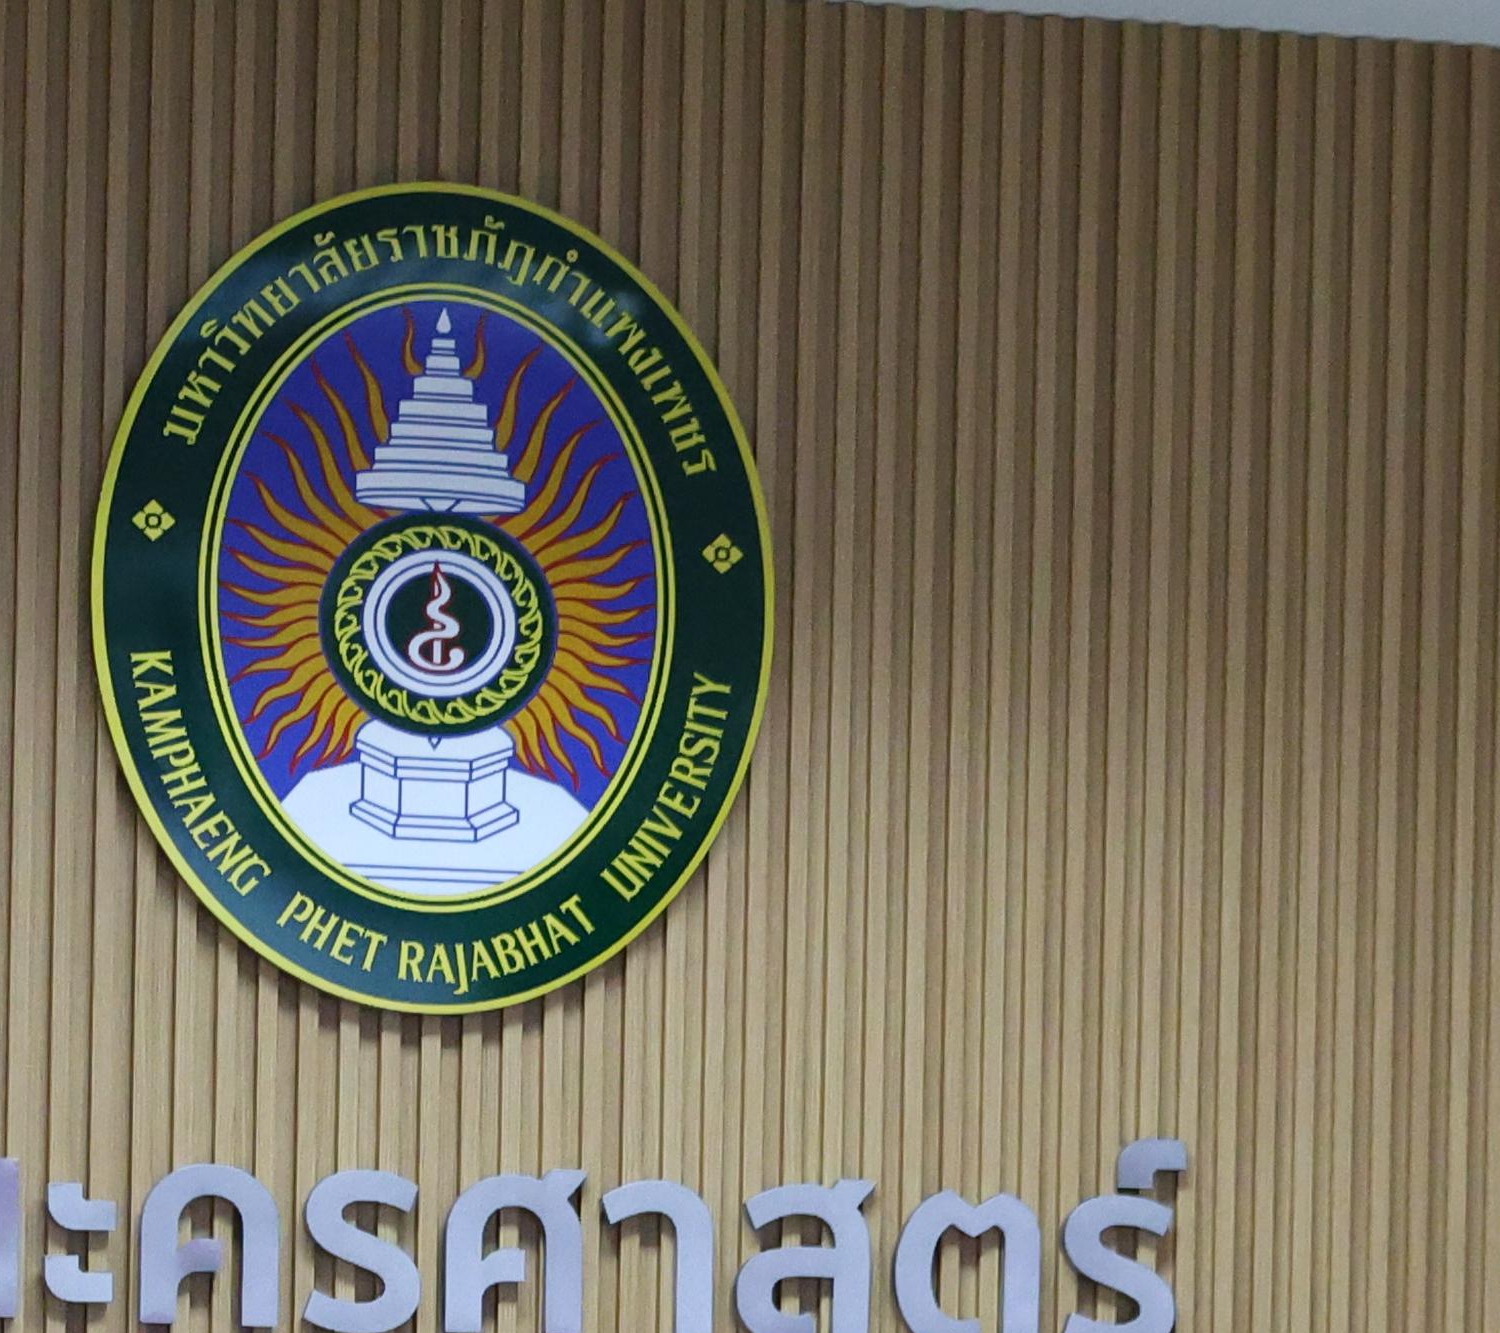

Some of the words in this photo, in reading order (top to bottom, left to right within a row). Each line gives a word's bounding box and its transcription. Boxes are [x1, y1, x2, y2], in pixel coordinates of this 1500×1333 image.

[129, 649, 271, 895] KAMPHAENG
[277, 893, 388, 972] PHET
[399, 897, 597, 995] RAJABHAT
[600, 672, 732, 901] UNIVERSITY
